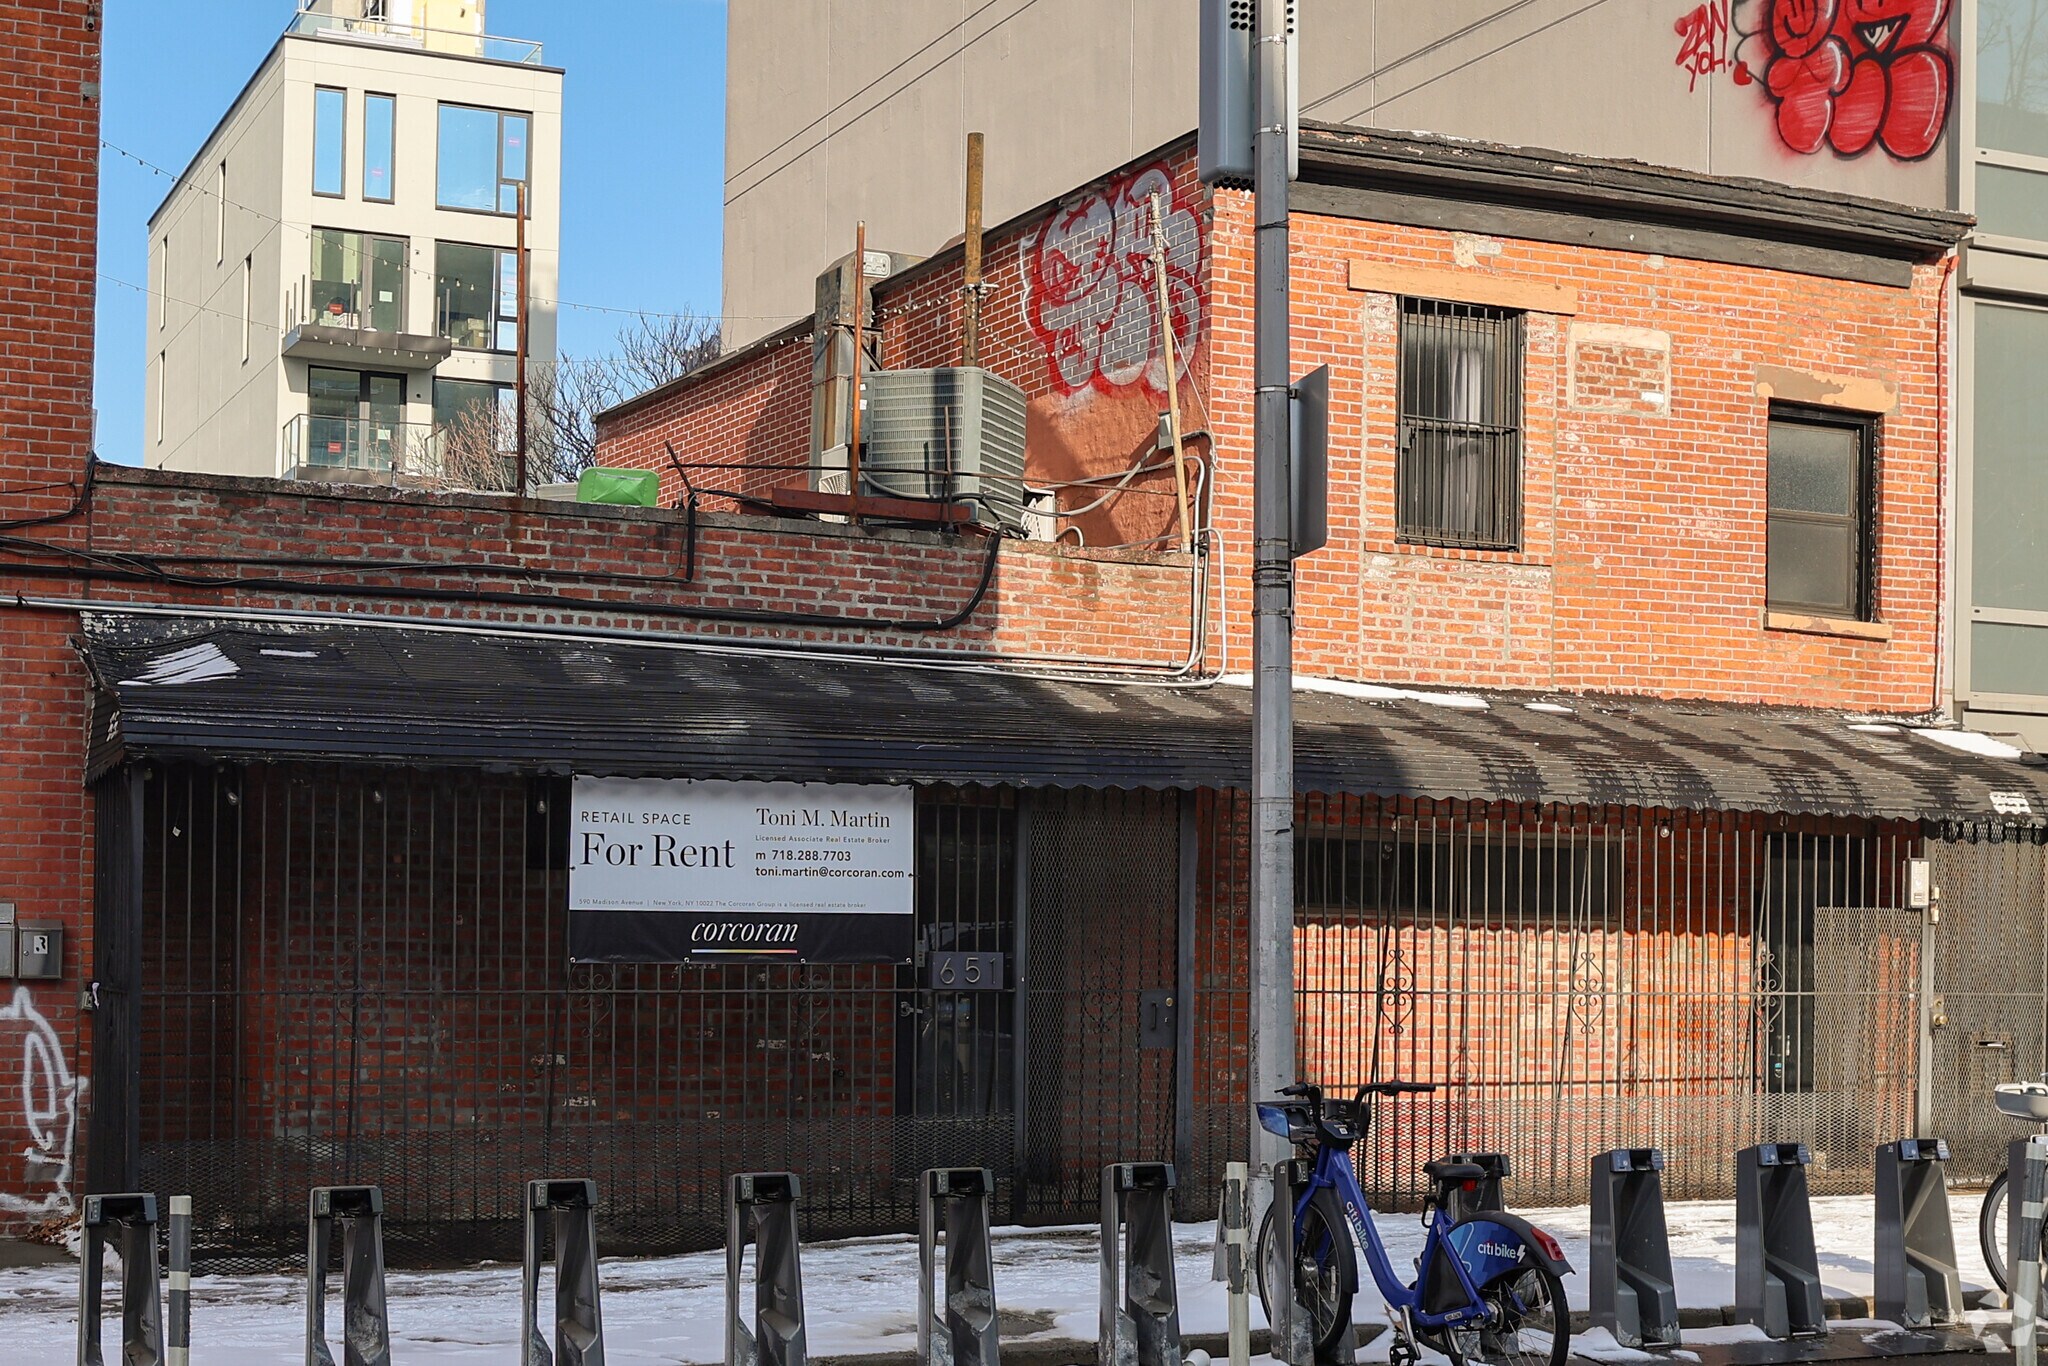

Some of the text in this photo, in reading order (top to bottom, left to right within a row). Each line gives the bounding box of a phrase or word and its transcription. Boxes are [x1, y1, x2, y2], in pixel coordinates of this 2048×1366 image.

[581, 811, 692, 826] RETAIL SPACE
[756, 808, 891, 828] Toni M. Martin
[843, 836, 865, 844] Estate
[580, 832, 736, 868] For Rent
[755, 850, 852, 861] m 718.288.7703
[755, 866, 904, 878] toni.martin@corcoran.com
[691, 922, 799, 942] corcoran
[940, 957, 996, 985] 651
